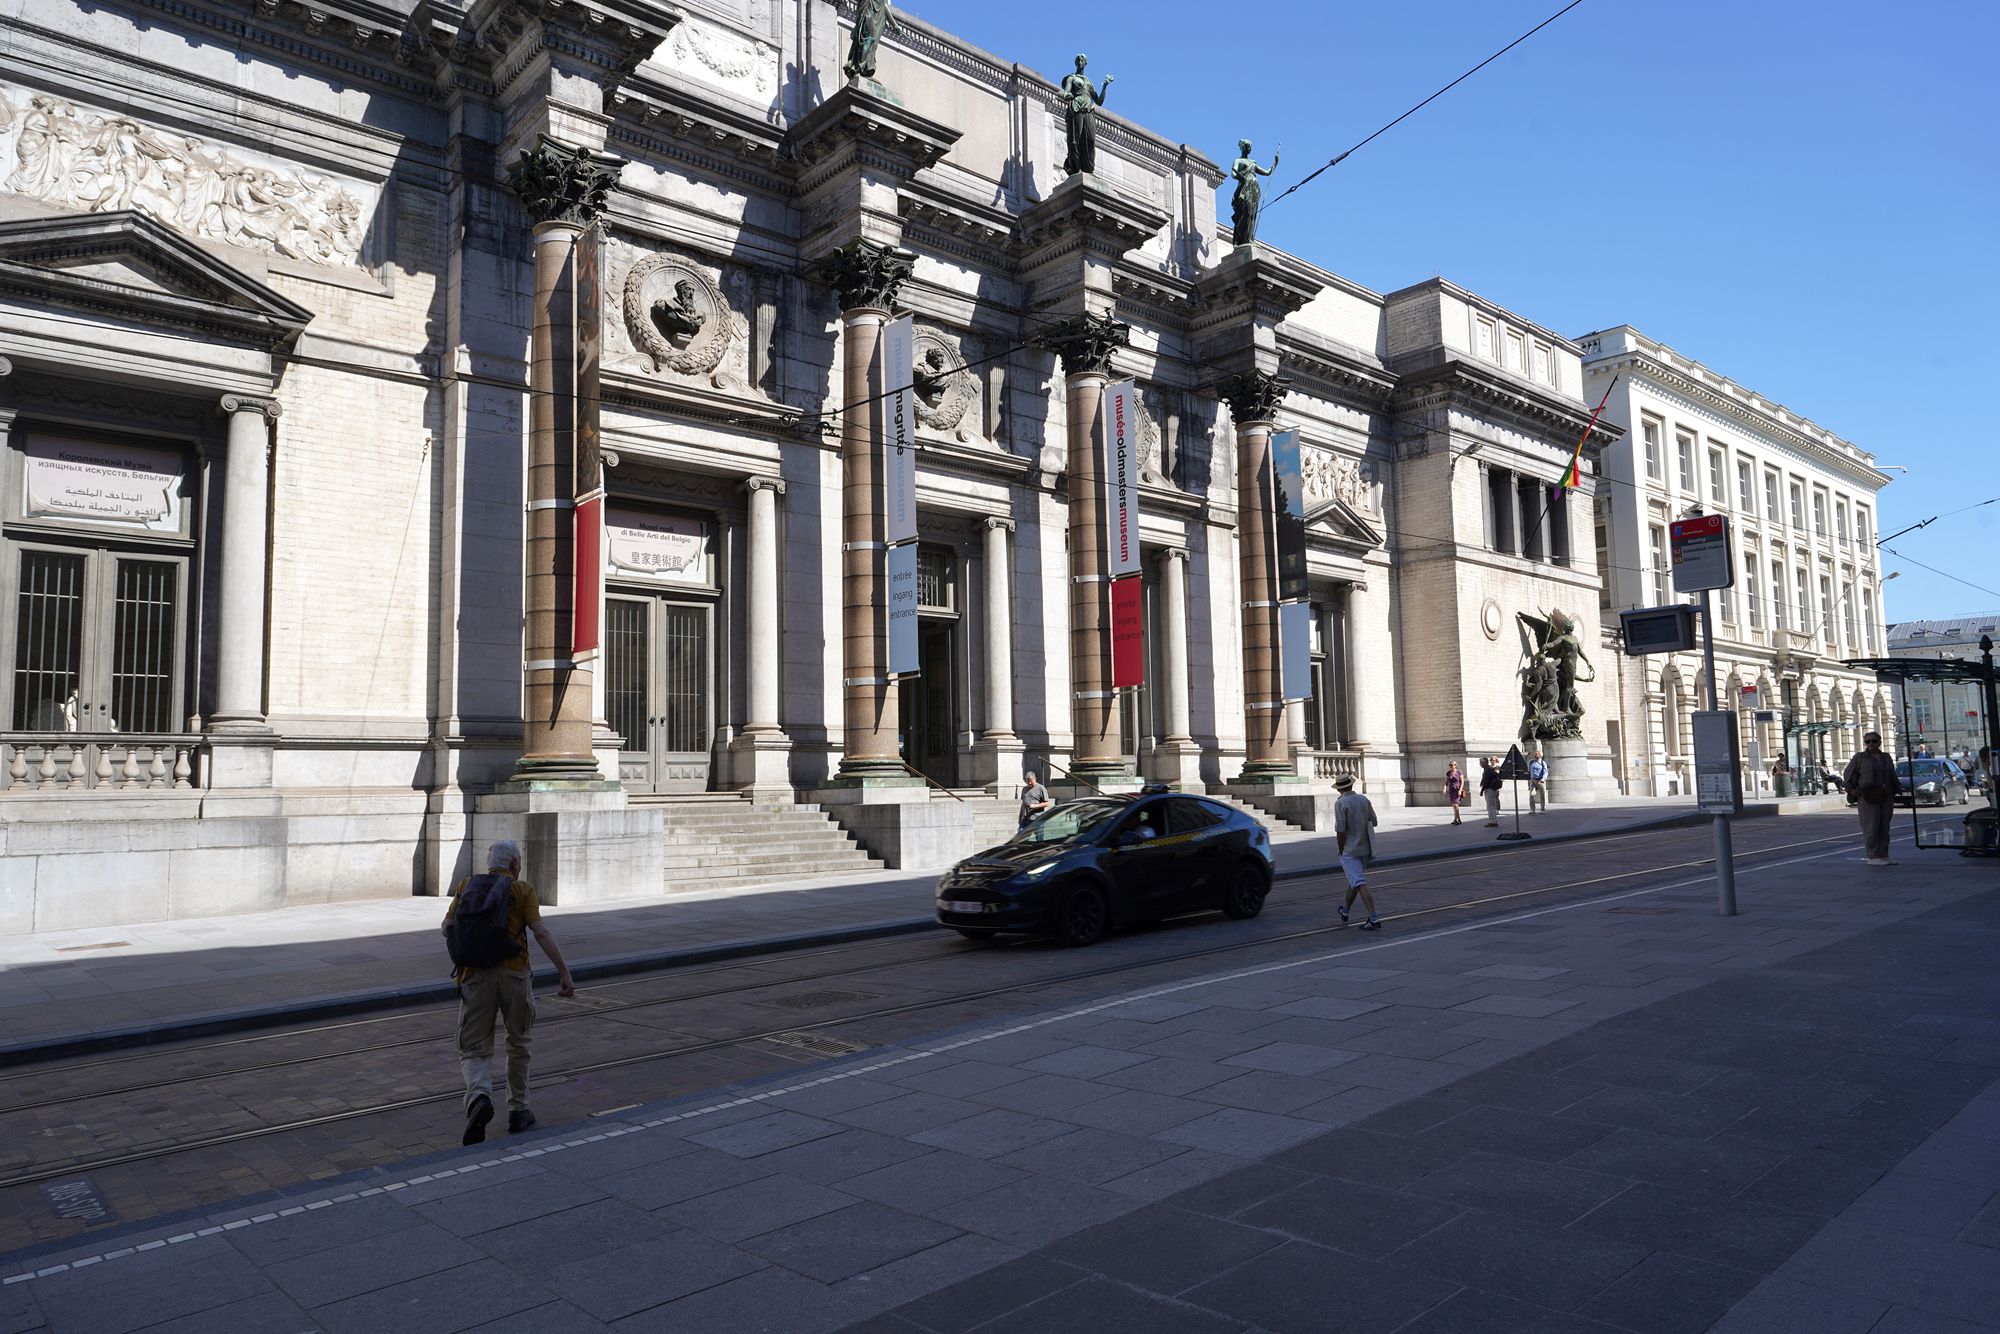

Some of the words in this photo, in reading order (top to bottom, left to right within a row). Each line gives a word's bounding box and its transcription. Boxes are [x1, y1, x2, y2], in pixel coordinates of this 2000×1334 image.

[59, 451, 122, 466] Королевский
[125, 459, 152, 471] Музей
[38, 461, 83, 472] изящных
[85, 467, 130, 478] искусств,
[132, 471, 170, 482] Бельгия
[1115, 394, 1130, 563] muséeoldmastersmuseum
[65, 486, 102, 498] الملكية
[104, 490, 143, 502] المتاحف
[639, 522, 658, 532] Musei
[646, 532, 659, 540] Arti
[631, 551, 682, 568] 皇家美術館
[892, 570, 912, 583] entrée
[892, 589, 913, 602] ingang
[1116, 600, 1137, 609] entrée
[890, 608, 916, 620] entrance
[1117, 616, 1137, 626] ingang
[1115, 632, 1140, 641] entrance
